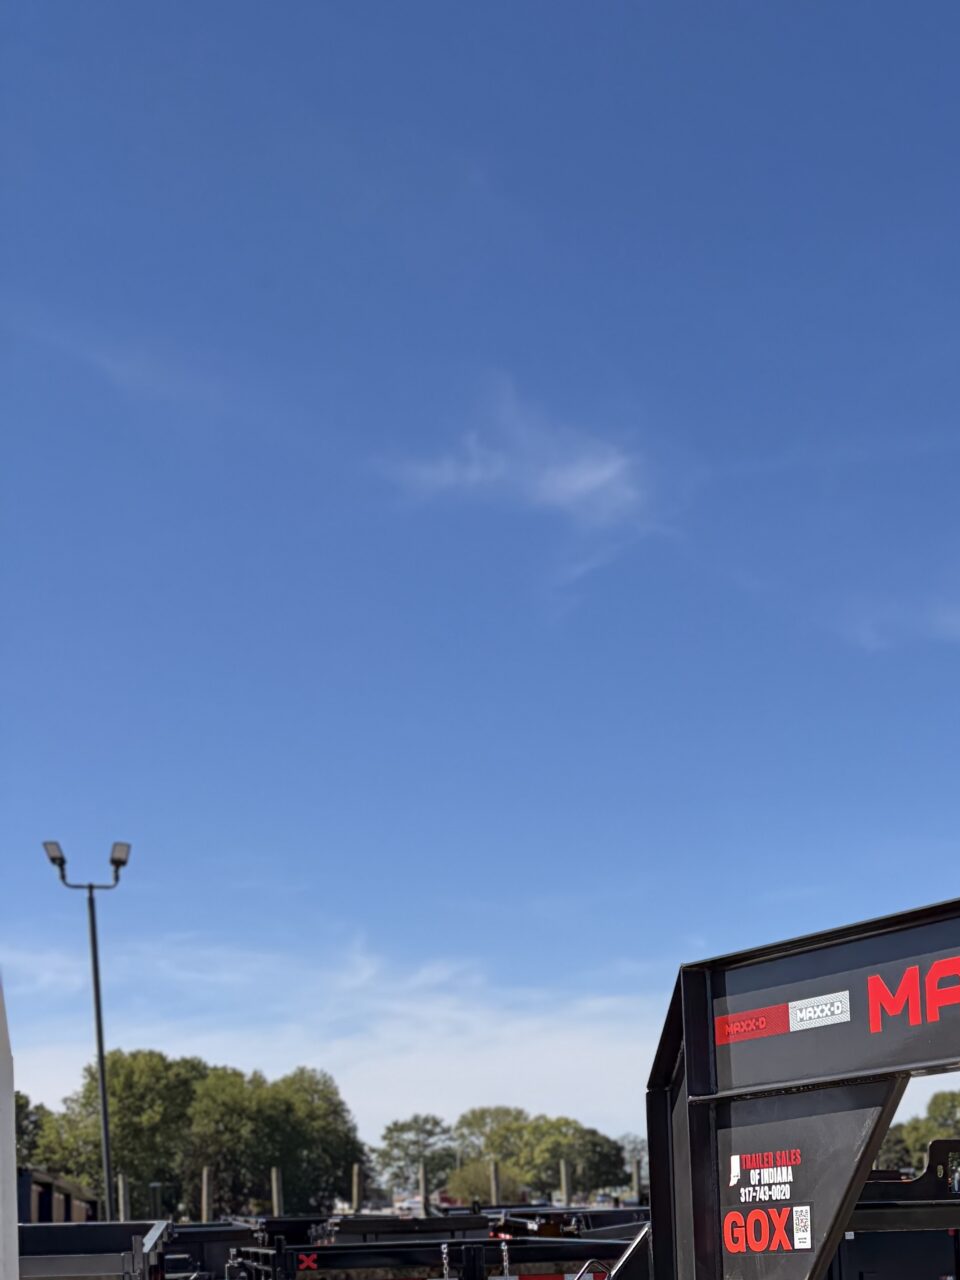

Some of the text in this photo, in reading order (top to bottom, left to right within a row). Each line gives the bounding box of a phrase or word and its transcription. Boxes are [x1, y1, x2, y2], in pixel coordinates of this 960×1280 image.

[796, 1001, 842, 1022] MAXX-D
[725, 1016, 766, 1036] MAXX-D
[741, 1149, 801, 1169] TRAILER SALES
[750, 1166, 793, 1185] OF INDIANA
[740, 1184, 790, 1203] 317-743-0020
[723, 1207, 793, 1254] GOX
